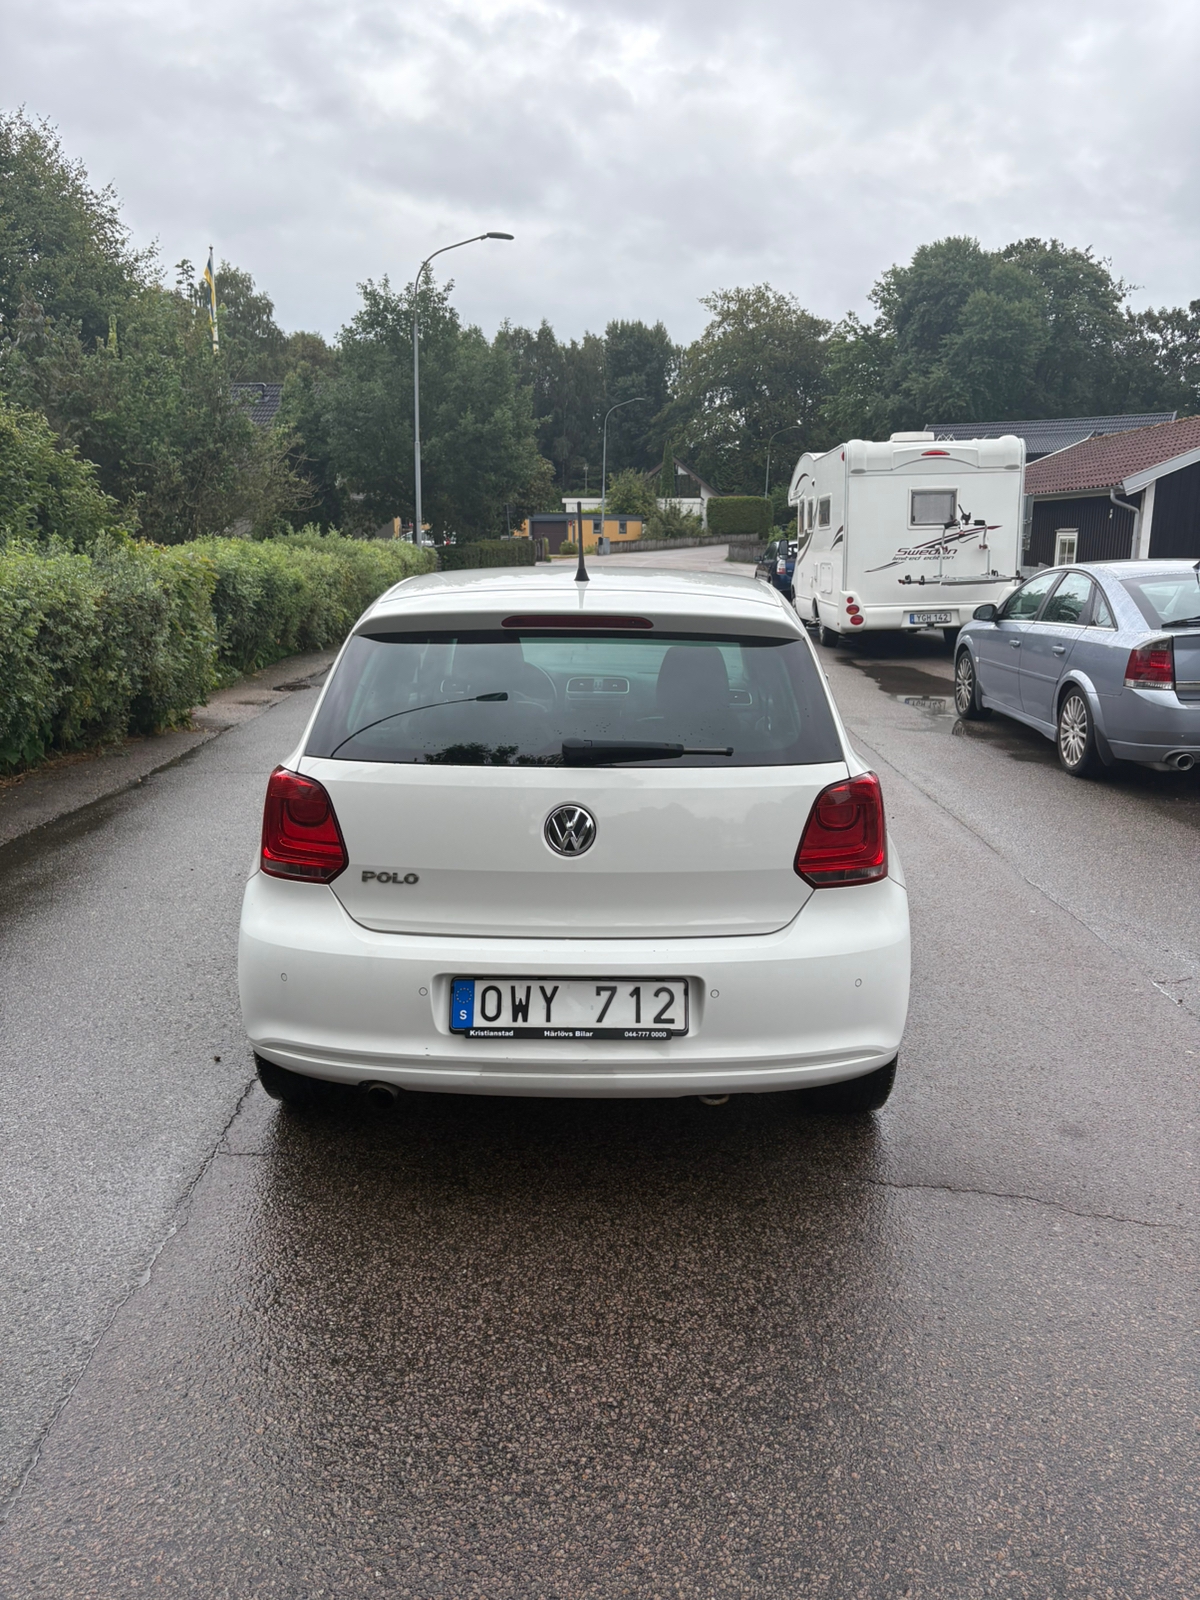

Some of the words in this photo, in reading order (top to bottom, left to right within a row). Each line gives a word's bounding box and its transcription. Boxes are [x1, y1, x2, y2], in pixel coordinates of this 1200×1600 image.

[916, 613, 932, 622] YGH
[934, 613, 948, 622] 142
[361, 871, 419, 885] POLO
[480, 985, 560, 1023] OWY
[595, 986, 675, 1024] 712
[459, 1009, 468, 1021] S
[469, 1029, 514, 1037] Kristianstad
